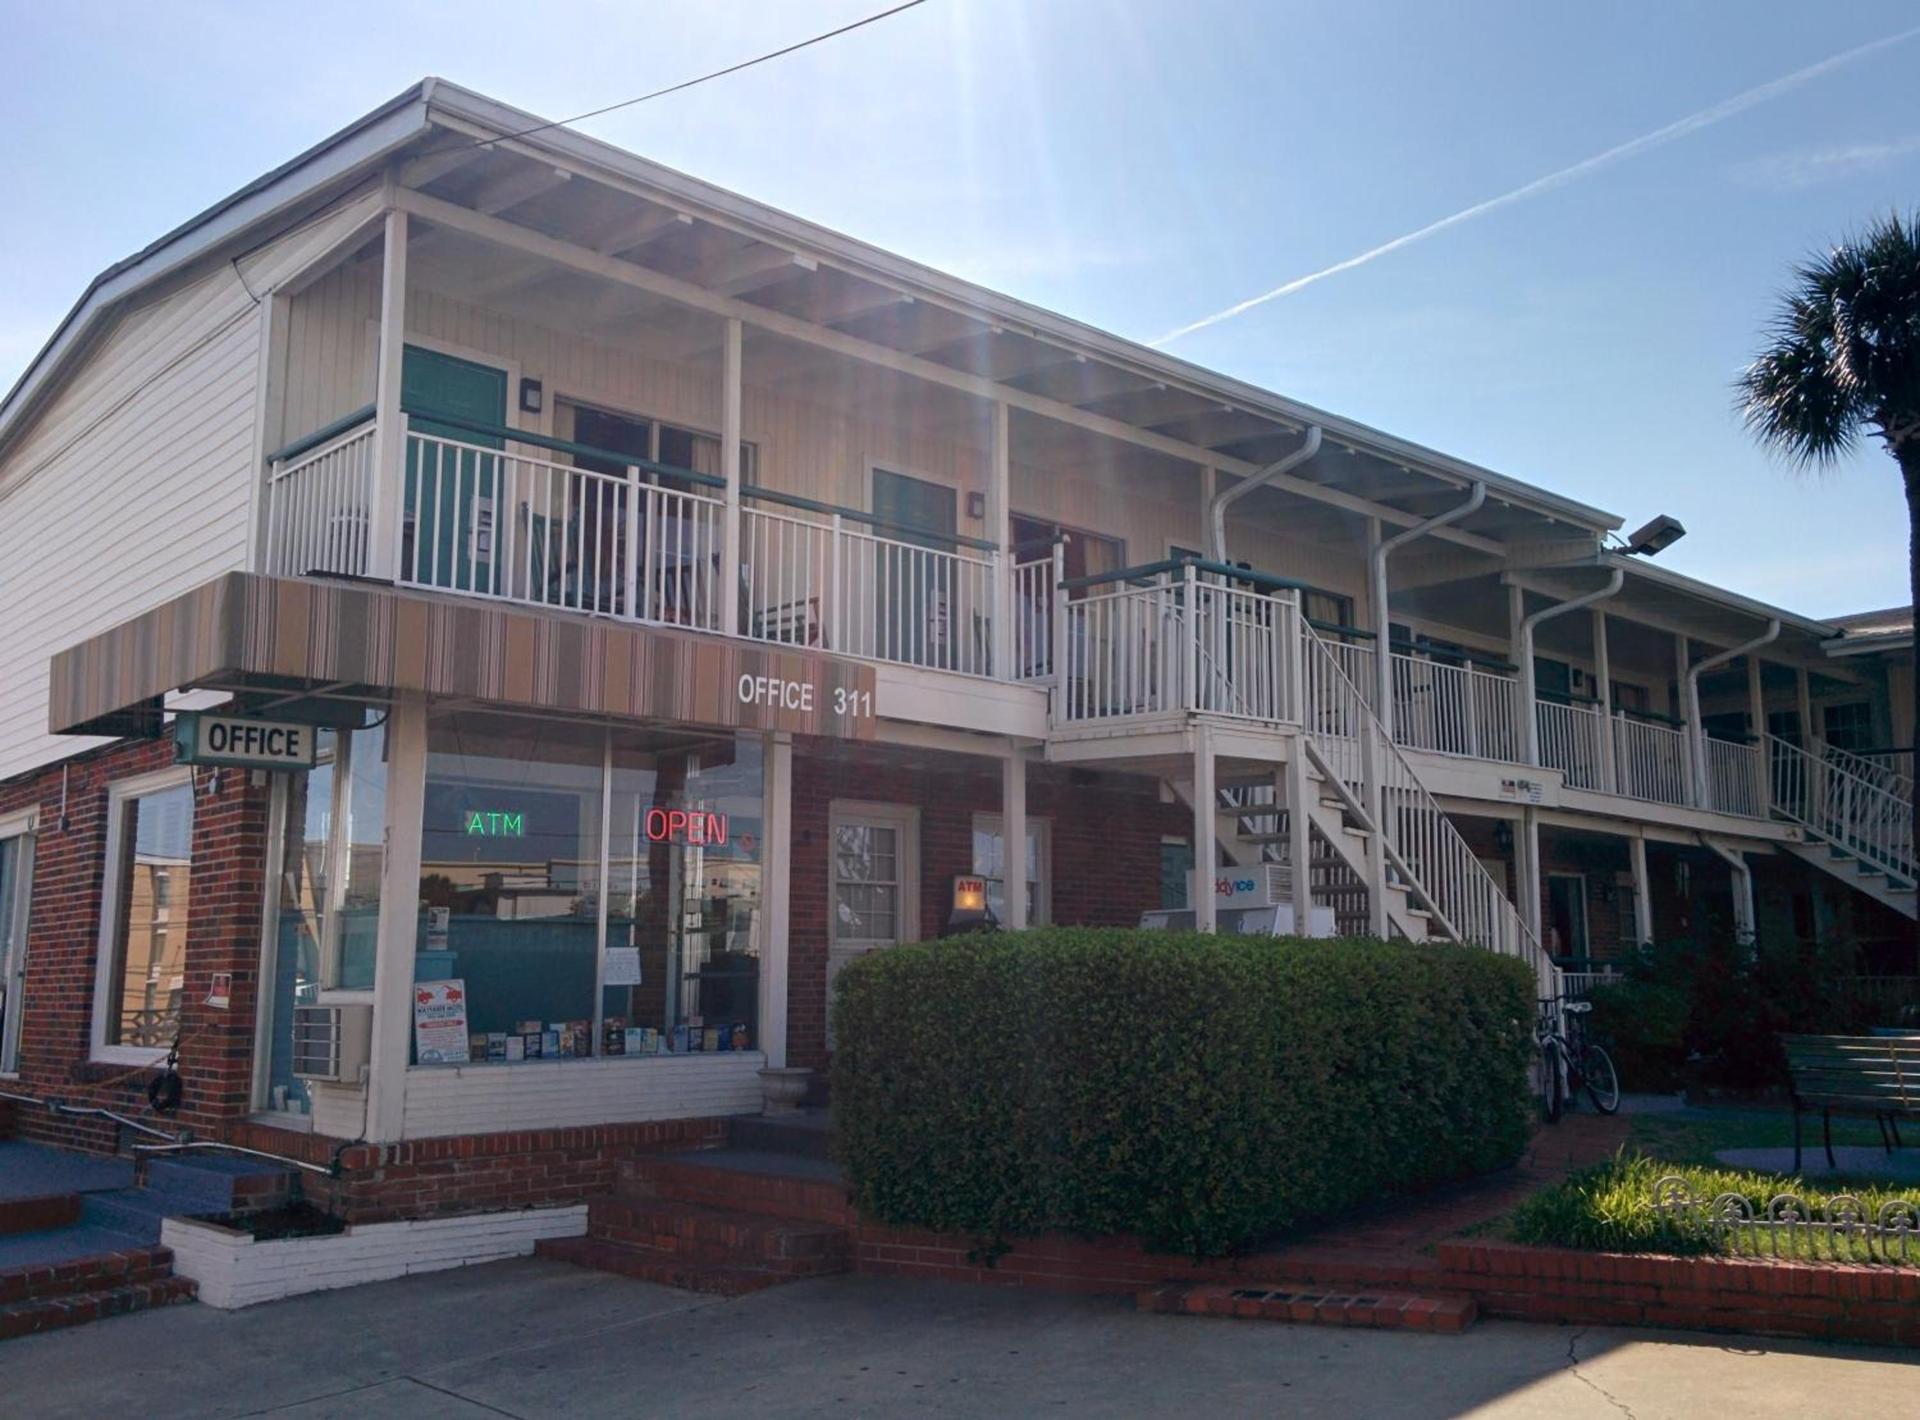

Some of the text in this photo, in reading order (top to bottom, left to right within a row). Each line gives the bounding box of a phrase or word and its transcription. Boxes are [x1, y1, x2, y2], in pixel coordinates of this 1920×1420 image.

[738, 673, 871, 718] OFFICE 311
[208, 722, 300, 757] OFFICE
[467, 812, 522, 836] ATM
[645, 808, 727, 845] OPEN
[958, 880, 983, 893] ATM
